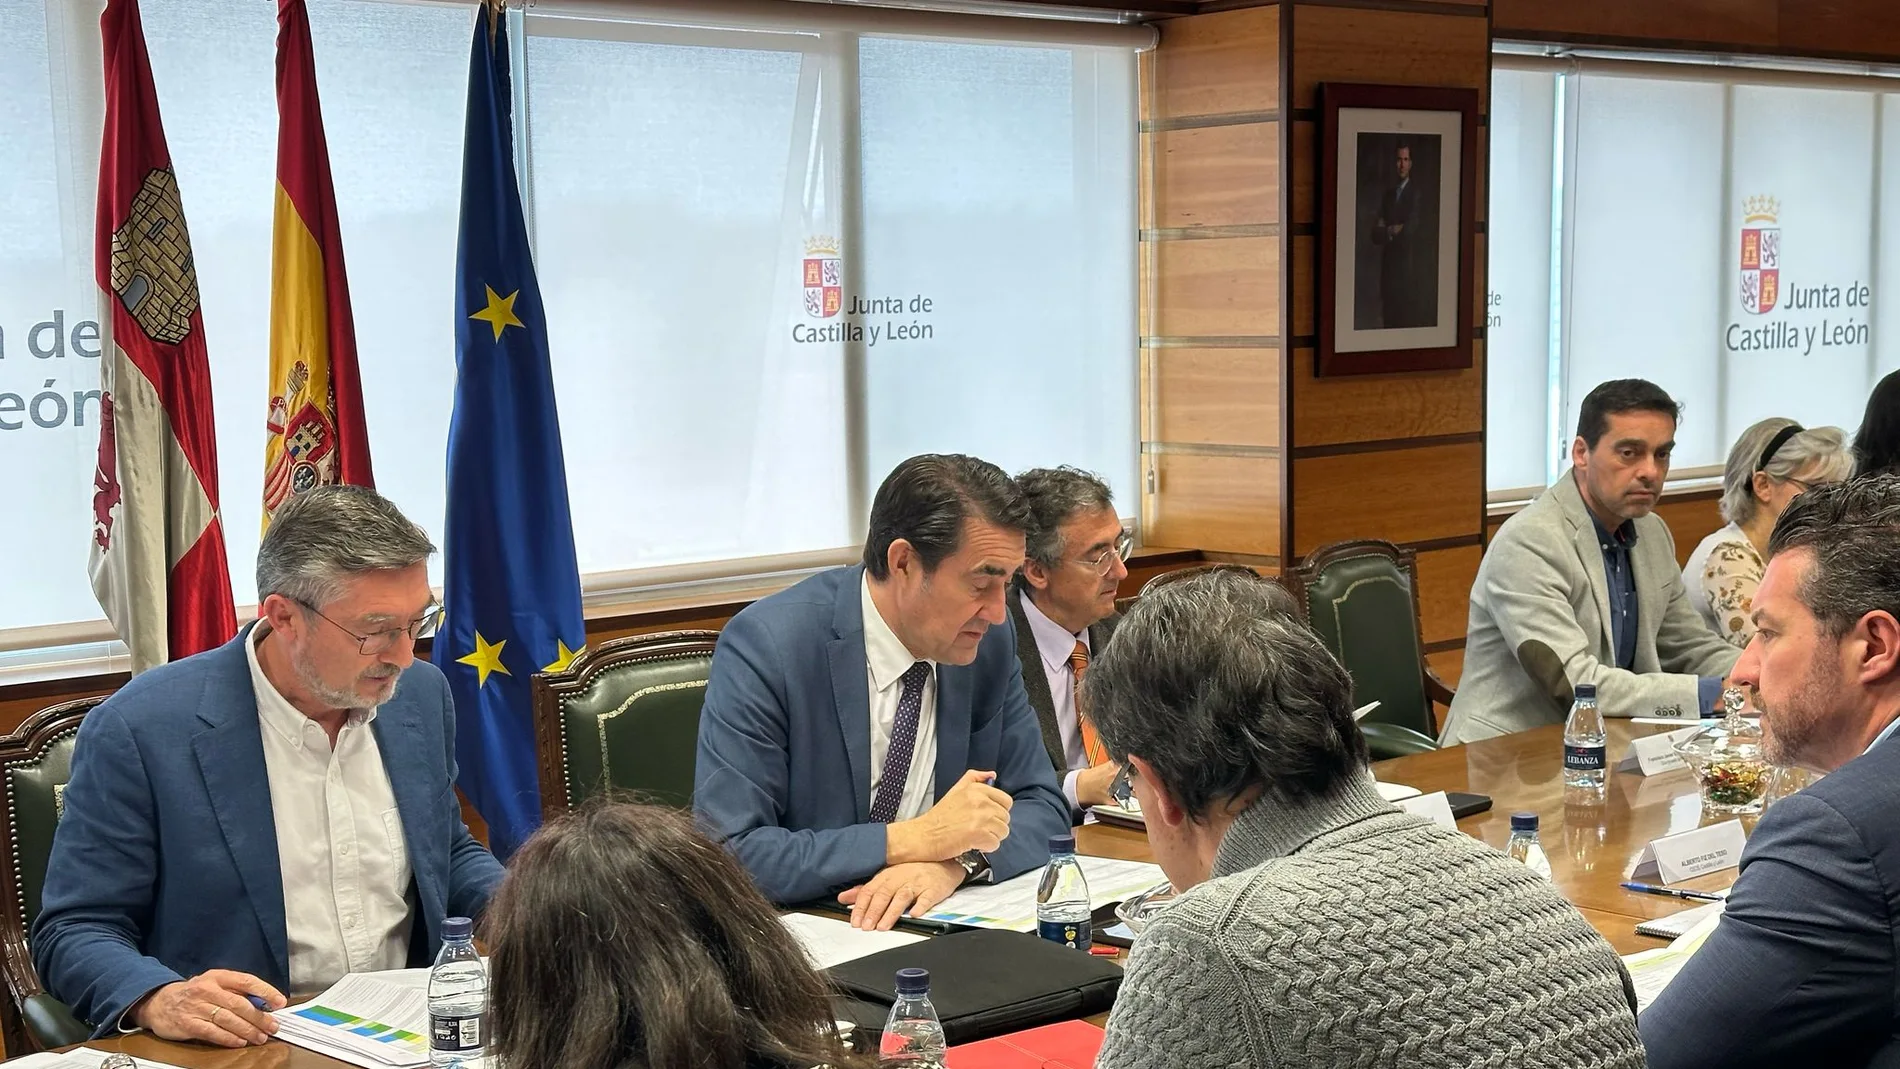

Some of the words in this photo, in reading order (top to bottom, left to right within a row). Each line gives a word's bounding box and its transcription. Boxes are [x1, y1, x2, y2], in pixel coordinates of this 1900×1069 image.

[847, 295, 903, 315] Junta
[909, 294, 933, 313] de
[1784, 281, 1840, 310] Junta
[1846, 280, 1870, 307] de
[27, 309, 101, 359] de
[792, 322, 864, 343] Castilla
[868, 325, 881, 347] y
[886, 320, 933, 340] León
[1726, 321, 1799, 351] Castilla
[1804, 325, 1817, 356] y
[1822, 318, 1870, 346] León
[0, 378, 101, 430] eón
[1567, 755, 1599, 765] LEBANZA
[1681, 856, 1701, 867] ALBERTO
